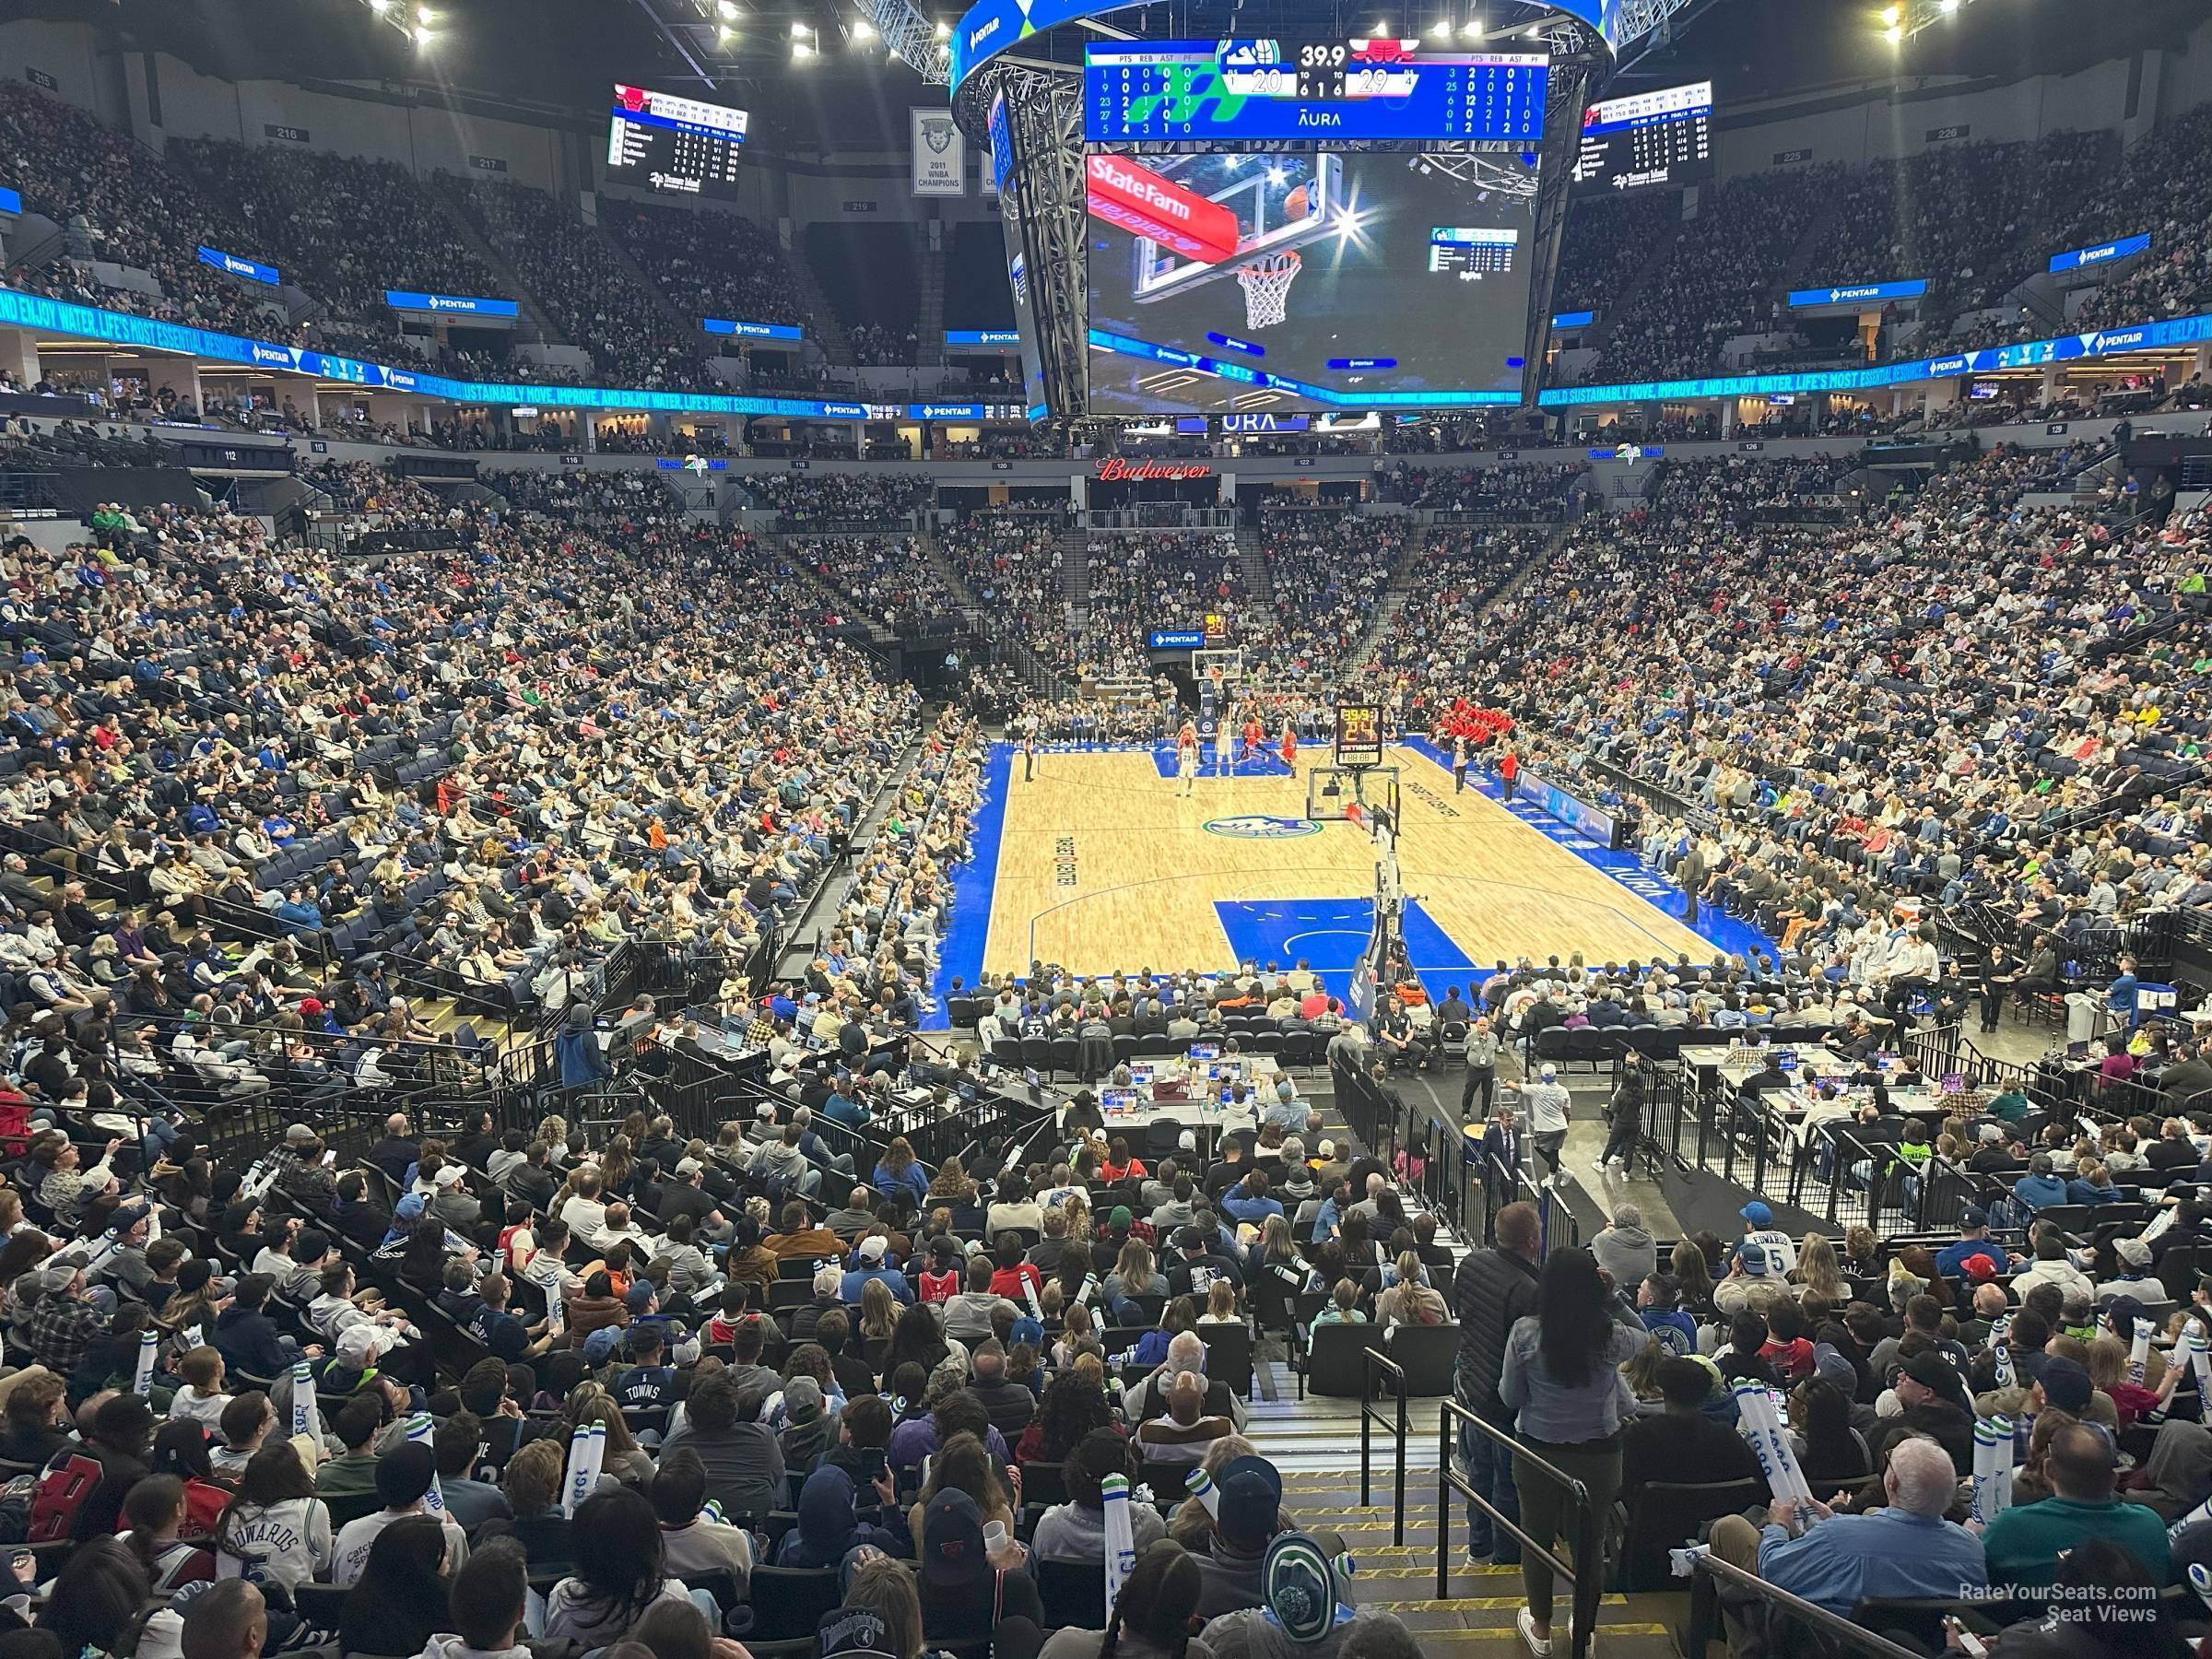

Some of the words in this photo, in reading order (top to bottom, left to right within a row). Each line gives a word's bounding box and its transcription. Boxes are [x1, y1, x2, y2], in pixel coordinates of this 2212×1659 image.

[975, 17, 1001, 44] PENTAIR
[1301, 46, 1345, 66] 39.9
[1122, 67, 1129, 77] 0
[1143, 68, 1149, 77] 0
[1163, 67, 1171, 77] 0
[1184, 67, 1191, 76] 0
[1450, 68, 1455, 77] 3
[1468, 67, 1476, 77] 2
[1488, 68, 1494, 77] 2
[1507, 68, 1514, 78] 0
[1252, 69, 1282, 93] 20
[1359, 69, 1388, 93] 29
[1406, 77, 1412, 86] 4
[1446, 83, 1457, 92] 25
[1467, 81, 1475, 92] 0
[1488, 81, 1494, 91] 0
[1506, 81, 1513, 92] 0
[1102, 83, 1109, 92] 9
[1122, 82, 1129, 92] 0
[1143, 82, 1149, 92] 0
[1163, 82, 1171, 92] 0
[1184, 82, 1191, 91] 0
[1300, 85, 1309, 96] 6
[1318, 82, 1324, 97] 1
[1334, 85, 1342, 96] 6
[1100, 98, 1111, 106] 23
[1123, 96, 1129, 106] 2
[1184, 96, 1191, 105] 0
[1448, 96, 1453, 105] 6
[1466, 95, 1476, 106] 12
[1487, 95, 1492, 105] 3
[1100, 111, 1111, 120] 27
[1123, 110, 1129, 120] 5
[1143, 110, 1149, 120] 2
[1163, 109, 1171, 120] 0
[1447, 110, 1453, 119] 0
[1465, 109, 1473, 119] 0
[1486, 109, 1492, 119] 2
[1524, 110, 1530, 119] 0
[1103, 124, 1109, 134] 5
[1122, 124, 1129, 134] 4
[1143, 124, 1149, 134] 3
[1183, 123, 1191, 133] 0
[1445, 124, 1453, 132] 11
[1465, 122, 1472, 133] 2
[1503, 122, 1510, 133] 2
[1523, 123, 1529, 133] 0
[277, 128, 298, 140] 216
[479, 159, 496, 169] 217
[930, 161, 946, 170] 2011
[918, 178, 959, 187] CHAMPIONS
[2086, 247, 2115, 261] PENTAIR
[231, 260, 254, 275] PENTAIR
[1841, 288, 1879, 299] PENTAIR
[440, 300, 476, 310] PENTAIR
[19, 297, 56, 327] ENJOY
[59, 303, 99, 337] WATER,
[99, 312, 130, 340] LIFE'S
[130, 319, 156, 345] MOST
[157, 324, 205, 351] ESSENTIAL
[743, 325, 771, 335] PENTAIR
[2152, 325, 2167, 345] WE
[2167, 321, 2194, 342] HELP
[2106, 332, 2143, 347] PENTAIR
[262, 350, 289, 364] PENTAIR
[1936, 360, 1962, 371] PENTAIR
[394, 375, 415, 386] PENTAIR
[1539, 389, 1568, 406] WORLD
[1569, 384, 1629, 403] SUSTAINABLY
[1630, 383, 1657, 400] MOVE,
[1658, 381, 1698, 398] IMPROVE,
[1700, 379, 1722, 395] AND
[1724, 378, 1756, 394] ENJOY
[1757, 374, 1794, 391] WATER,
[1797, 373, 1828, 389] LIFE'S
[1829, 371, 1858, 388] MOST
[1860, 369, 1889, 387] ESSENTIAL
[526, 387, 556, 405] MOVE,
[557, 388, 599, 406] IMPROVE,
[601, 390, 620, 406] AND
[622, 391, 651, 407] ENJOY
[652, 393, 683, 410] WATER,
[683, 394, 710, 410] LIFE'S
[710, 396, 735, 412] MOST
[735, 398, 777, 413] ESSENTIAL
[832, 406, 861, 415] PENTAIR
[314, 442, 324, 452] 113
[225, 451, 237, 461] 112
[1095, 457, 1210, 481] Budweiser
[1207, 621, 1223, 634] 24
[1027, 1025, 1044, 1037] 32
[1753, 1232, 1788, 1246] EDWARDS
[1769, 1249, 1785, 1273] 5
[625, 1383, 661, 1401] TOWNS
[234, 1523, 300, 1553] DWARDS
[241, 1552, 271, 1583] 5
